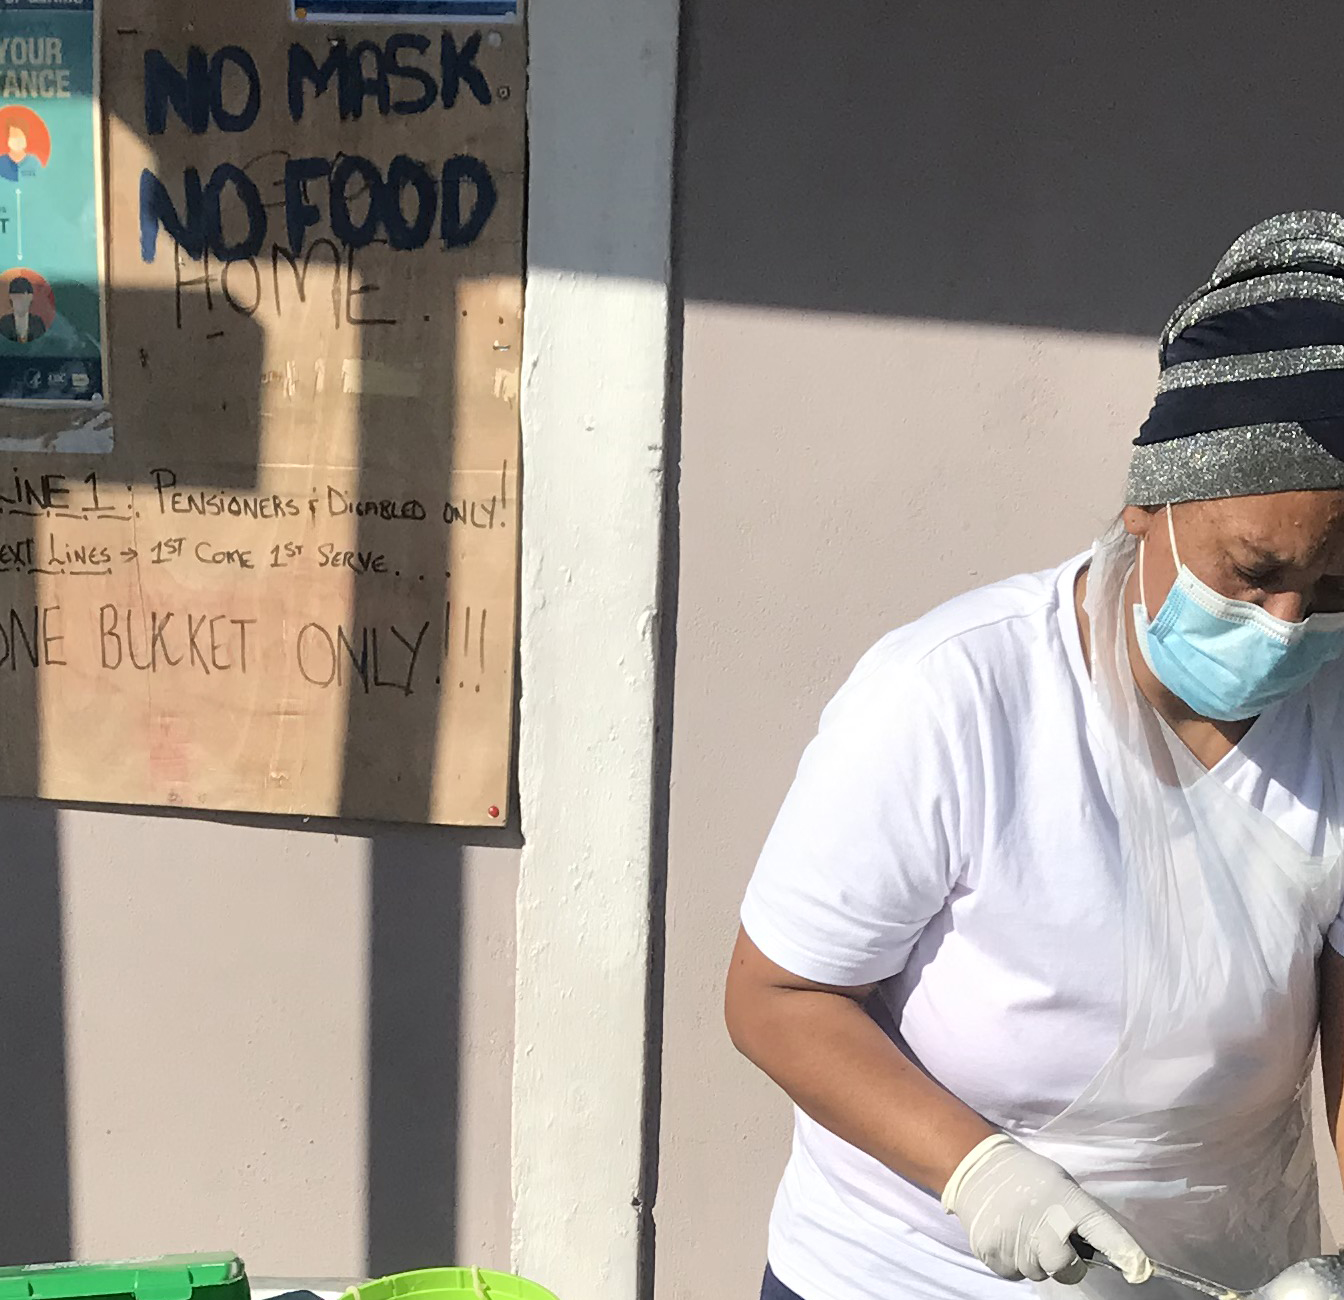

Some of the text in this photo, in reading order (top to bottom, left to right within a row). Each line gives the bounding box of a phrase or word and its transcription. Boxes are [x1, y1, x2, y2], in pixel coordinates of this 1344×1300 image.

[144, 29, 492, 135] NO MASK
[139, 162, 267, 264] NO
[285, 153, 497, 256] FOOD
[443, 459, 507, 529] ONLY!
[195, 542, 256, 569] COME
[99, 602, 258, 675] BUCKET
